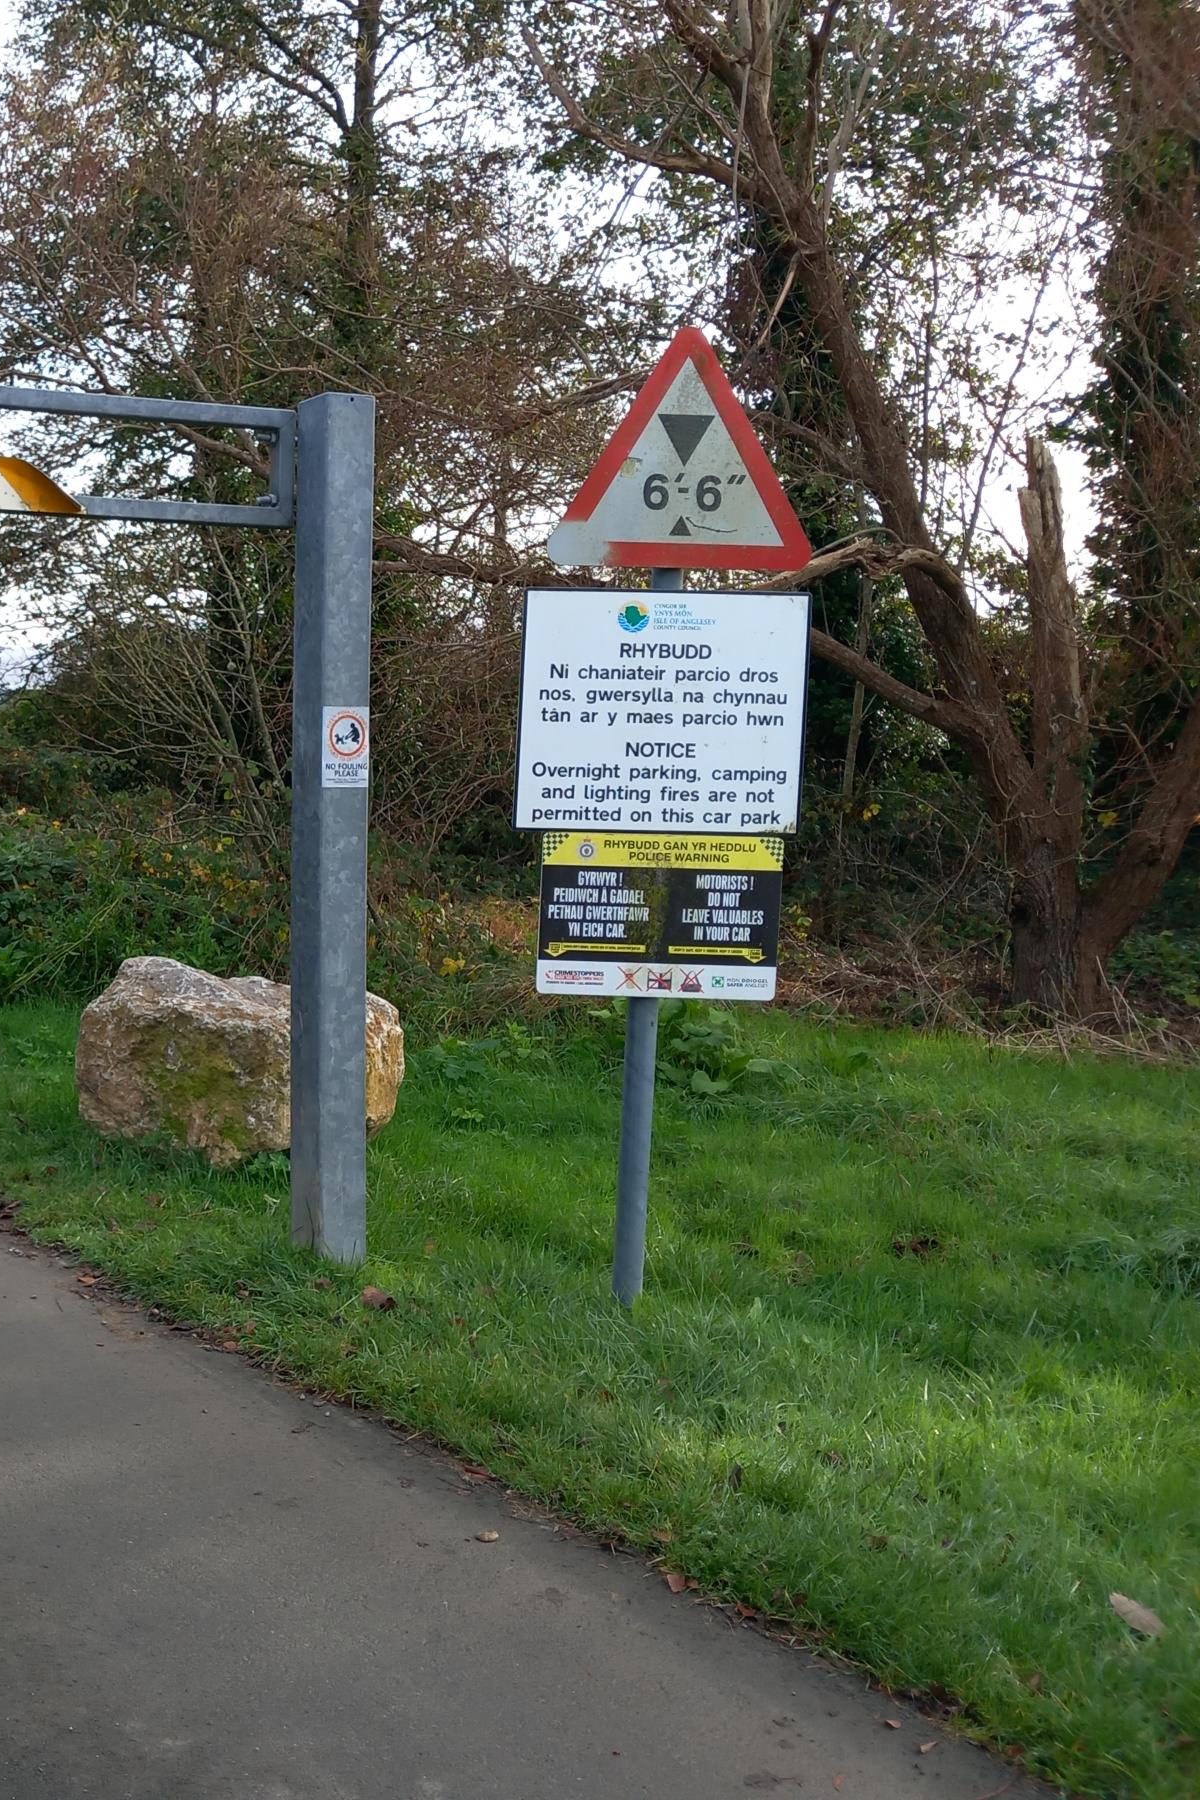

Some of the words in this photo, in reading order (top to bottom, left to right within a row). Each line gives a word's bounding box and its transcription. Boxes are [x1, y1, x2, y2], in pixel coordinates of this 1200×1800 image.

[653, 617, 667, 625] ISLE
[680, 618, 716, 626] ANGLESEY
[619, 643, 712, 660] RHYBUDD
[550, 663, 569, 680] Ni
[578, 665, 666, 682] chaniateir
[674, 667, 730, 685] parcio
[739, 667, 779, 684] dros
[539, 686, 576, 703] nos,
[586, 687, 674, 705] gwersylla
[682, 690, 704, 704] na
[712, 689, 788, 707] chynnau
[580, 710, 599, 723] ar
[607, 711, 618, 727] y
[626, 711, 674, 725] maes
[682, 710, 738, 728] parcio
[746, 710, 785, 727] hwn
[625, 741, 697, 759] NOTICE
[531, 761, 621, 781] Overnight
[629, 764, 702, 783] parking,
[711, 767, 788, 785] camping
[541, 784, 575, 800] and
[584, 784, 651, 803] lighting
[660, 786, 700, 802] fires
[708, 790, 737, 803] are
[745, 789, 775, 804] not
[531, 806, 622, 823] permitted
[629, 809, 652, 823] on
[661, 808, 695, 824] this
[702, 811, 732, 824] car
[740, 809, 781, 827] park
[604, 839, 660, 851] RHYBUDD
[663, 841, 689, 852] GAN
[691, 842, 707, 852] YR
[709, 843, 757, 853] HEDDLU
[628, 851, 672, 862] POLICE
[674, 852, 730, 863] WARNING
[577, 871, 617, 887] GYRWYR
[695, 874, 748, 891] MOTORISTS
[553, 887, 599, 903] PEIDIWCH
[609, 889, 645, 905] GADAEL
[707, 892, 721, 907] DO
[722, 892, 741, 907] NOT
[547, 904, 584, 920] PETHAU
[585, 905, 650, 922] GWERTHFAWR
[681, 908, 710, 924] LEAVE
[711, 909, 764, 926] VALUABLES
[568, 921, 580, 937] YN
[582, 922, 604, 938] EICH
[605, 923, 628, 938] CAR.
[693, 925, 704, 941] IN
[705, 926, 730, 941] YOUR
[731, 926, 751, 942] CAR
